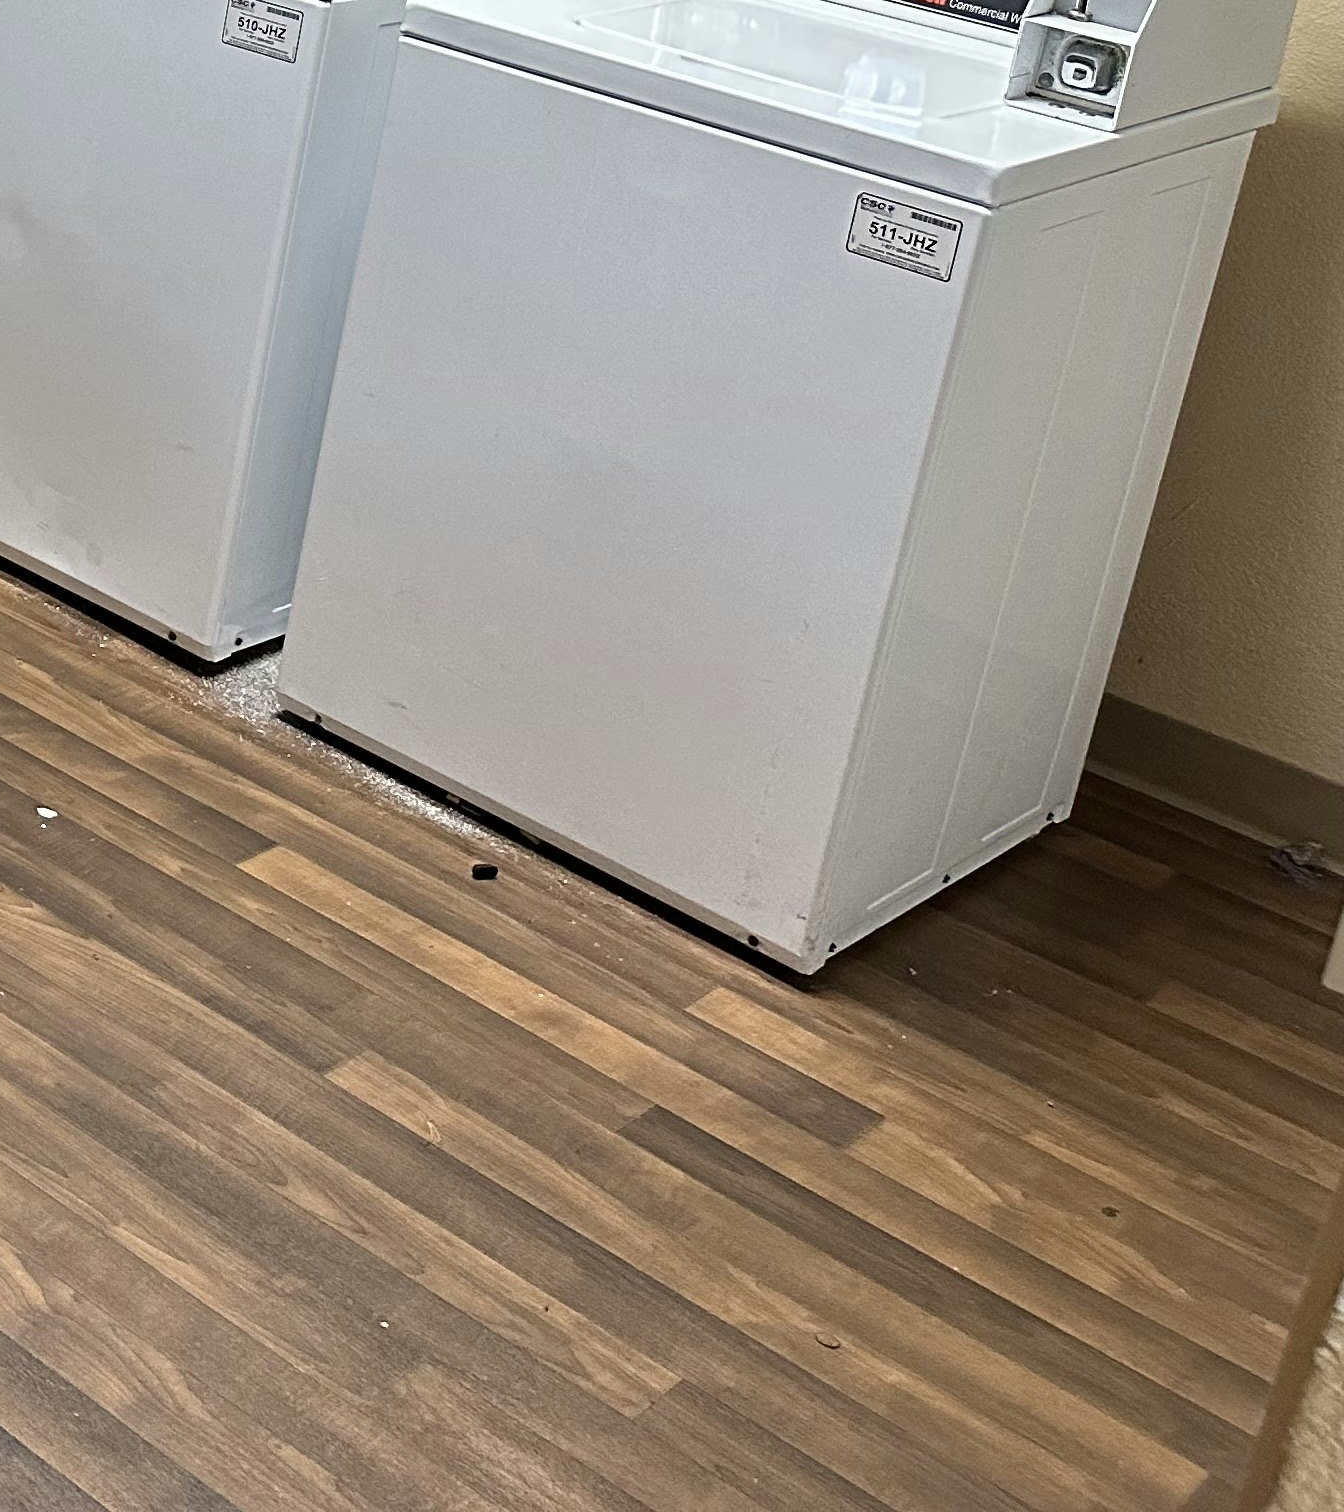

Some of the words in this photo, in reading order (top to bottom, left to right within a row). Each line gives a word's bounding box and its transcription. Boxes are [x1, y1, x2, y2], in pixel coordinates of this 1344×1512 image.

[237, 16, 287, 40] 510-JHZ
[860, 197, 887, 211] CSC
[868, 221, 938, 253] 511-JHZ
